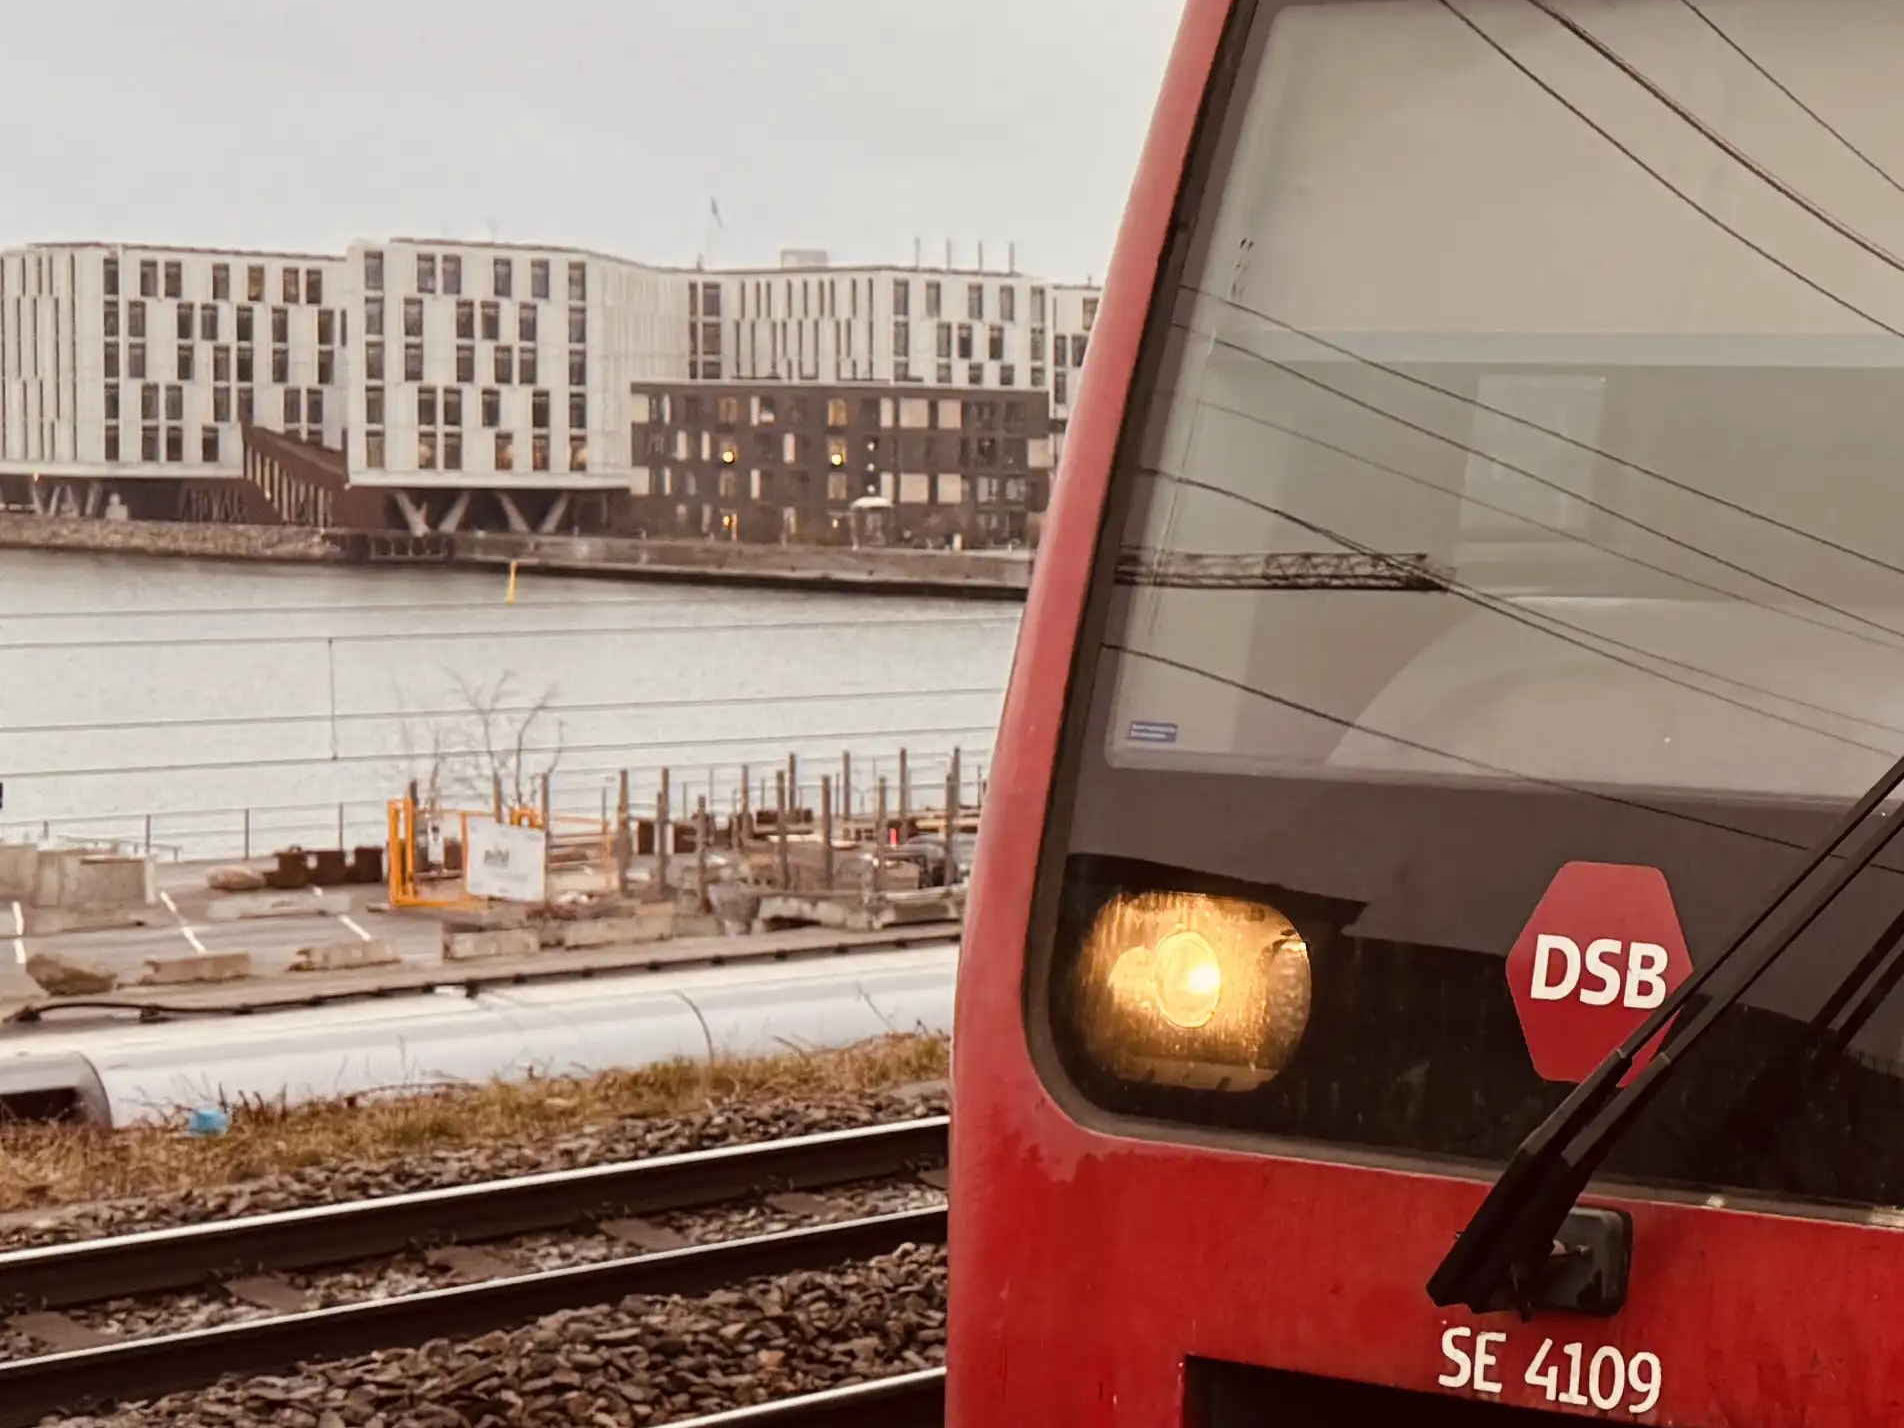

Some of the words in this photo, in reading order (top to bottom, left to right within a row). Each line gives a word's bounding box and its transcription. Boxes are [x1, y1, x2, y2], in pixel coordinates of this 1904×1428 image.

[1529, 933, 1669, 1010] DSB
[1437, 1325, 1507, 1393] SE
[1523, 1337, 1662, 1414] 4109
